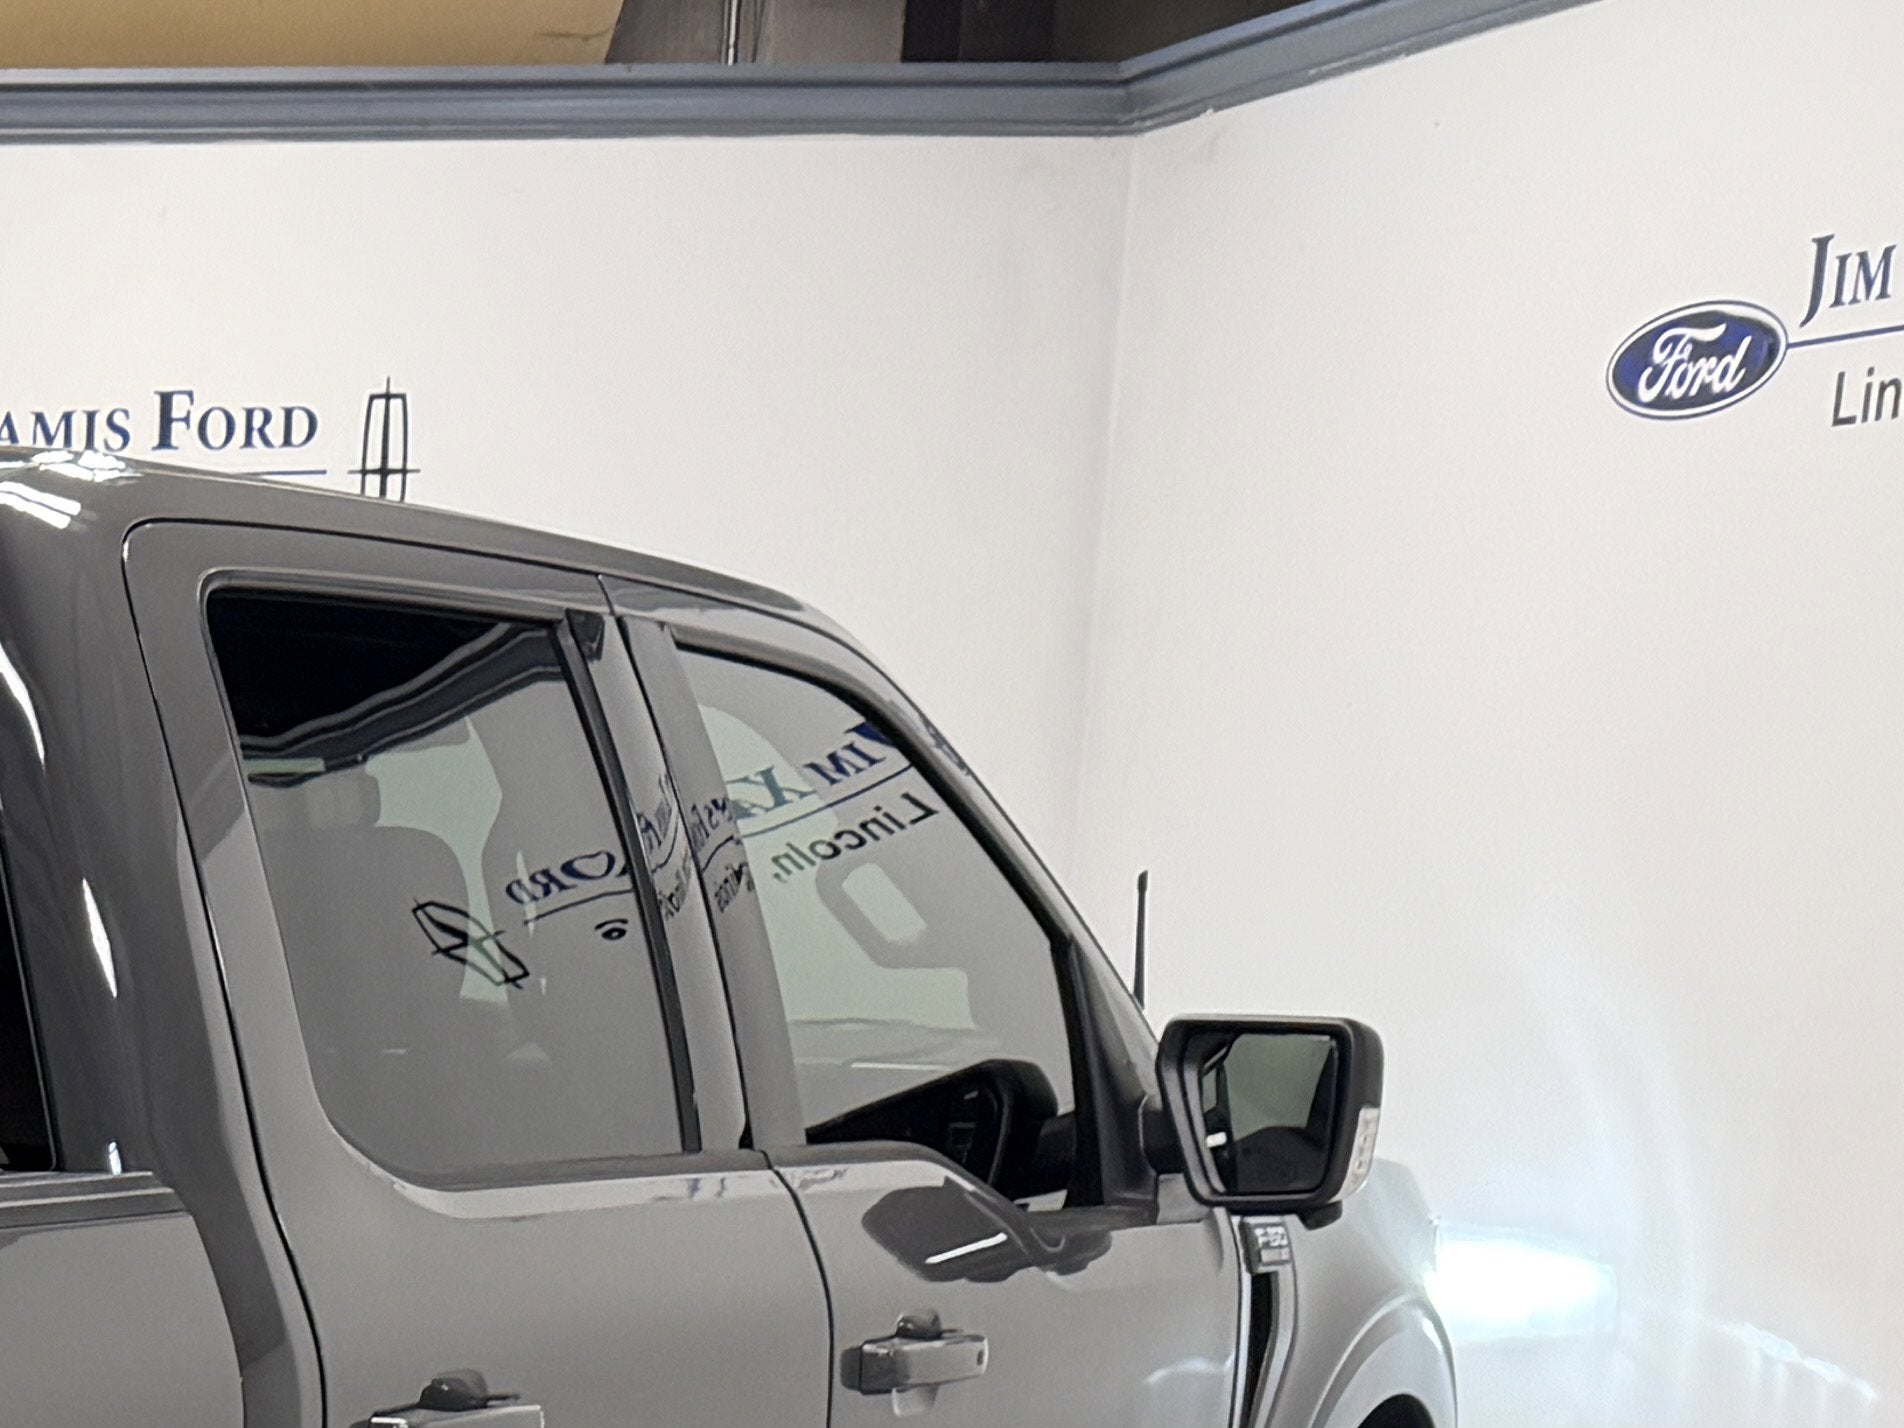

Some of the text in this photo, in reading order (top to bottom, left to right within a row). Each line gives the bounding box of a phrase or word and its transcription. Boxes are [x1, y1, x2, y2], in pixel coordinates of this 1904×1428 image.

[1799, 233, 1897, 328] JIM
[1637, 322, 1753, 404] Ford
[152, 389, 320, 452] FORD
